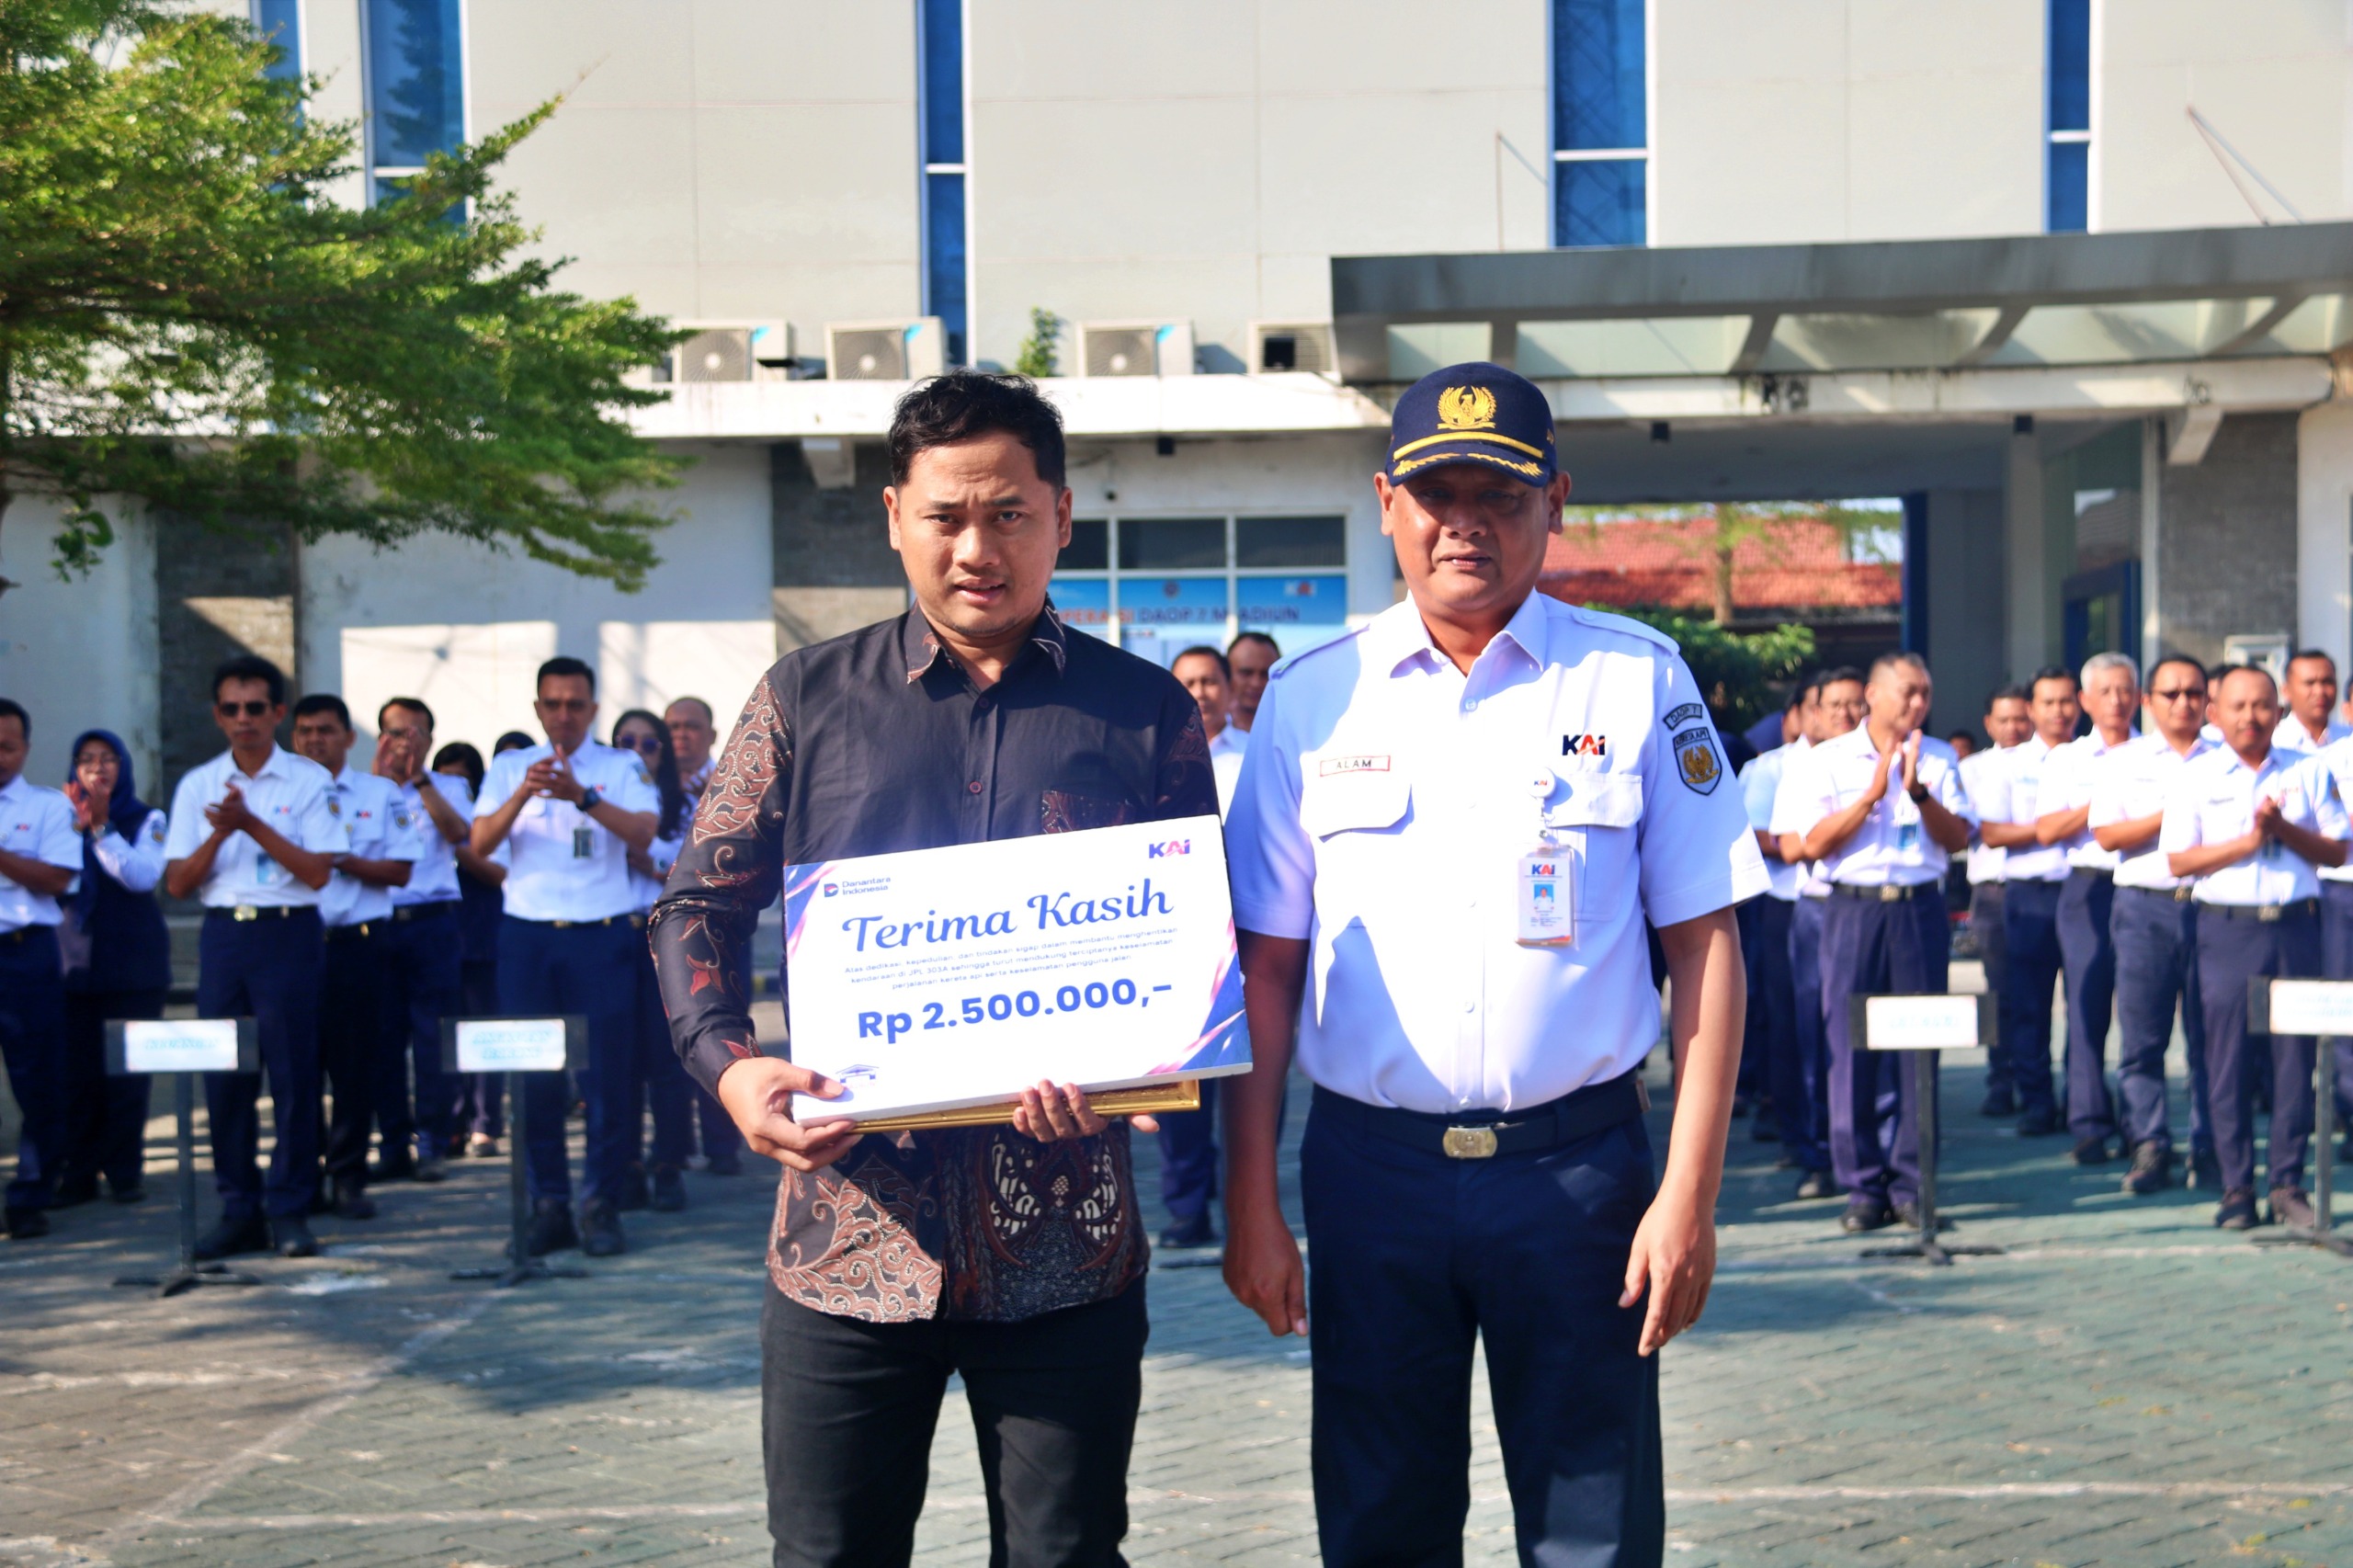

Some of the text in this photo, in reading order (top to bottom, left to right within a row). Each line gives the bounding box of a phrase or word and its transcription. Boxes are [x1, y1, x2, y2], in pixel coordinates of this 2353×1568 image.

[1670, 706, 1689, 722] DAOP
[1562, 734, 1606, 756] KAI
[1336, 759, 1372, 769] ALAM
[1149, 839, 1190, 858] KAI
[1531, 864, 1555, 876] KAI
[842, 877, 892, 888] Danantara
[842, 884, 889, 896] Indonesia
[842, 878, 1175, 952] Terima Kasih
[858, 1010, 913, 1044] Rp
